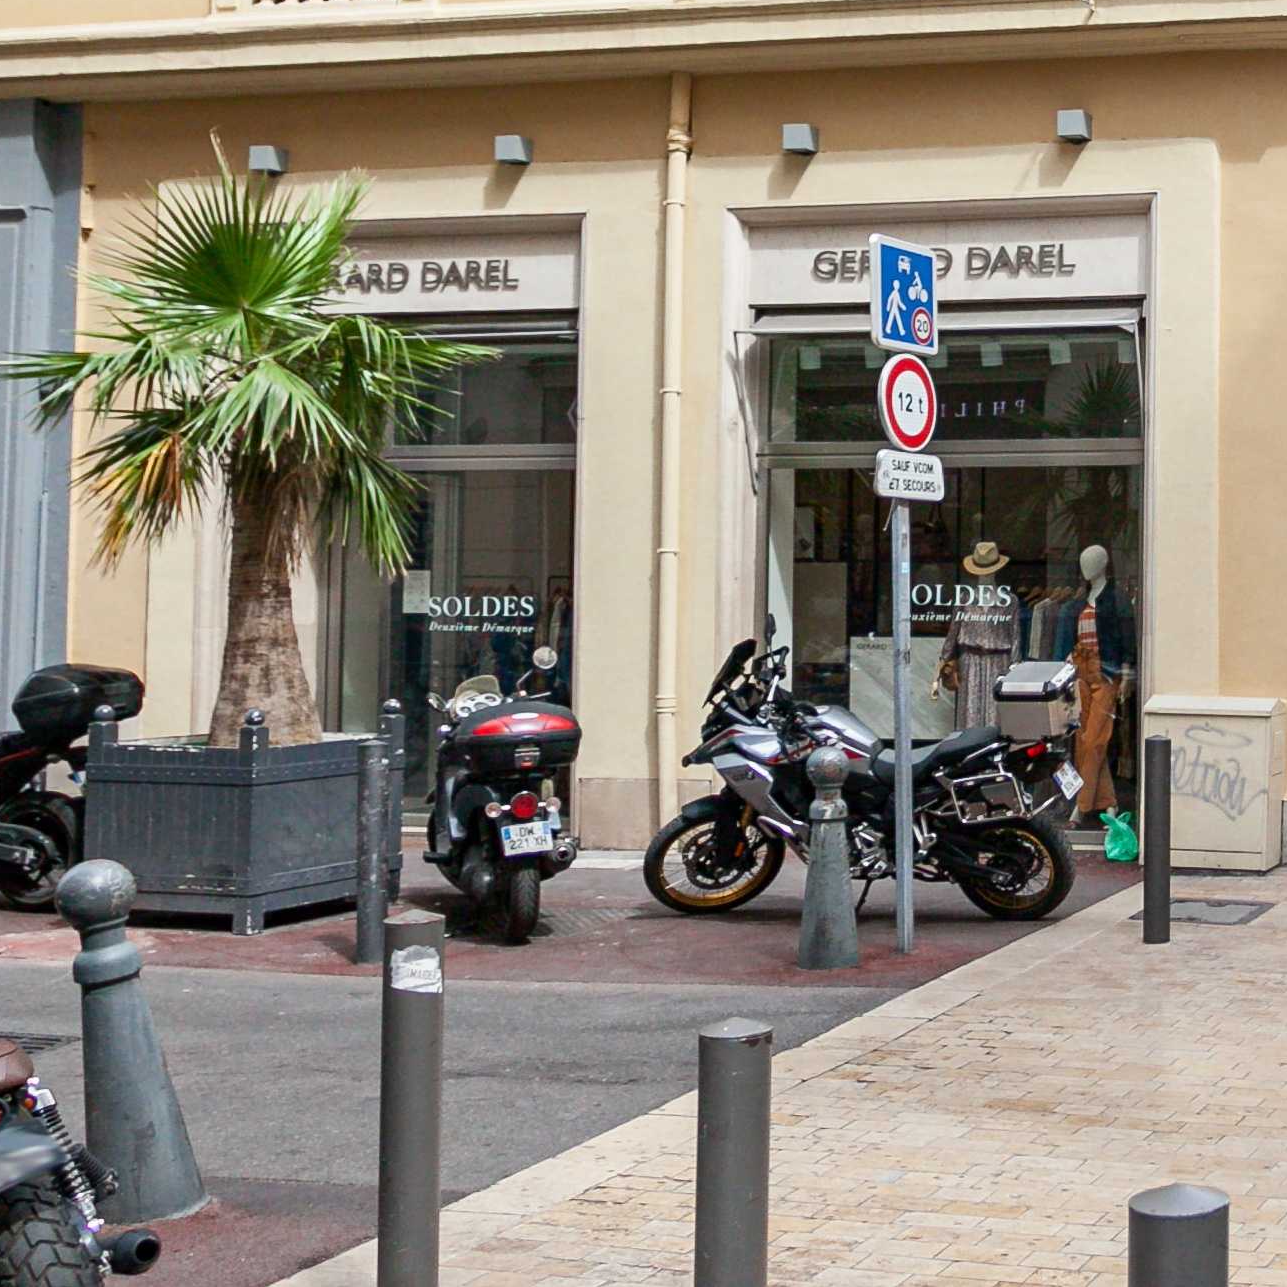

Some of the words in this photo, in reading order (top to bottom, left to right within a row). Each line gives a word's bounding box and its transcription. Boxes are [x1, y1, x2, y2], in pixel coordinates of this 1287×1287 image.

[965, 243, 1076, 280] DAREL
[421, 259, 519, 293] DAREL
[916, 319, 929, 334] 20
[898, 391, 914, 413] 12
[918, 397, 925, 414] t
[891, 459, 911, 472] SAUF
[902, 479, 936, 493] SECOURS
[911, 584, 1012, 607] OLDES
[428, 595, 535, 618] SOLDES
[909, 611, 952, 623] uxième
[954, 611, 1012, 626] Démarque
[428, 621, 480, 632] Deuxième
[481, 622, 535, 636] Démarque
